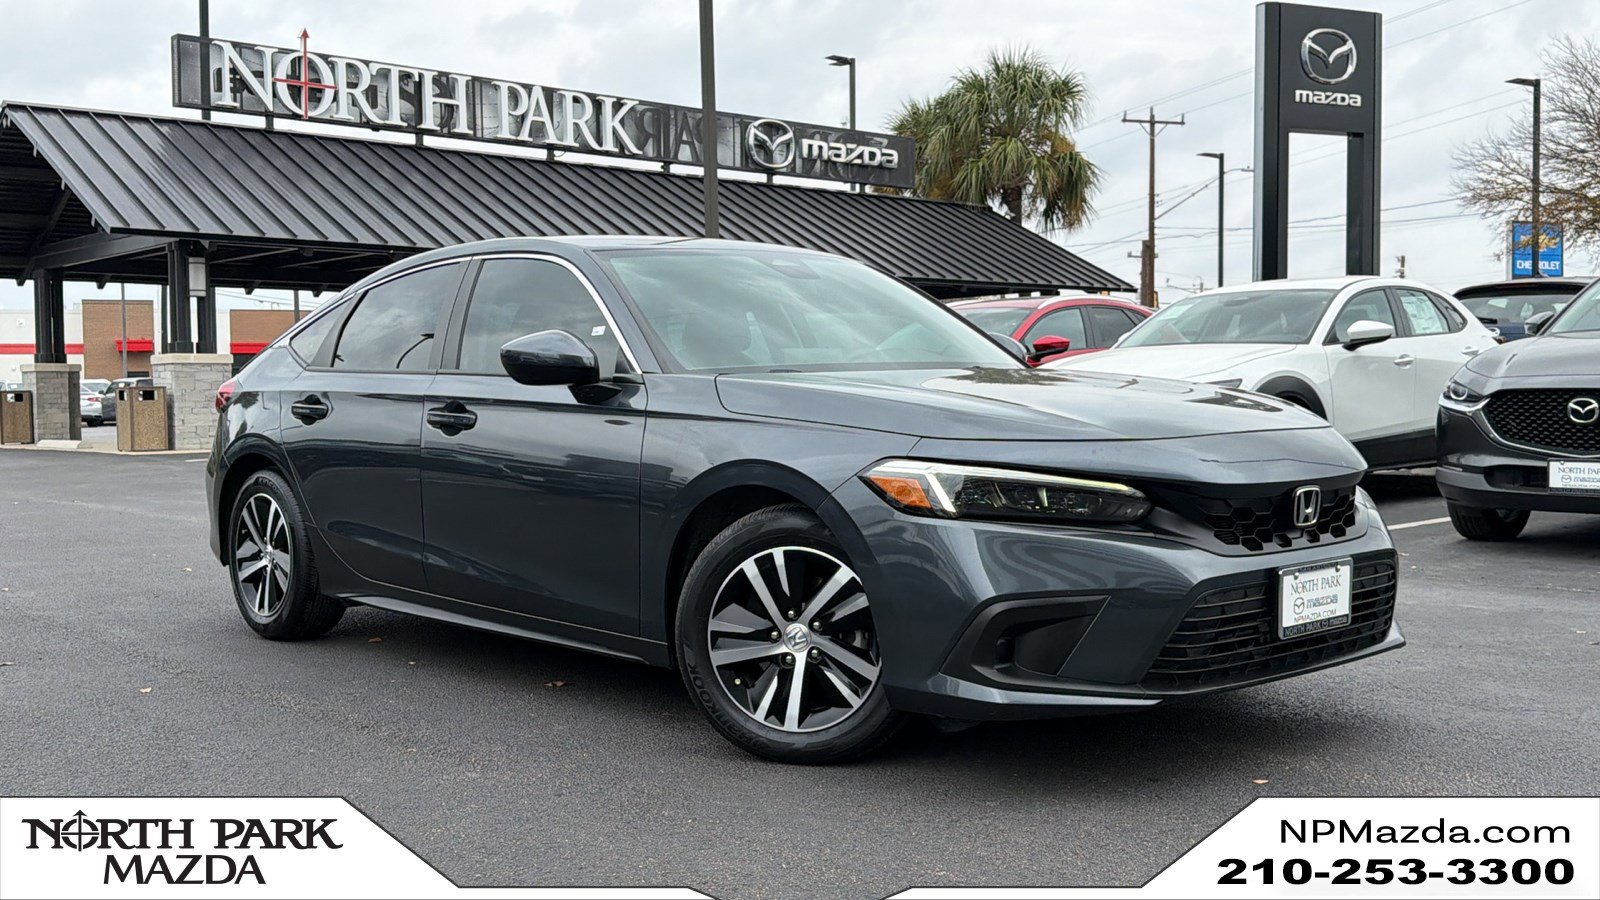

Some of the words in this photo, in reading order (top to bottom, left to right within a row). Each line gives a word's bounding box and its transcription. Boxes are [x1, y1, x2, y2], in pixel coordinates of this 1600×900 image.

[211, 39, 473, 134] NORTH
[491, 80, 643, 155] PARK
[1295, 89, 1362, 107] mazda
[801, 138, 899, 168] mazda
[1516, 260, 1560, 270] CHEROLET
[1291, 578, 1318, 595] NORTH
[1321, 575, 1342, 589] PARK
[1307, 594, 1338, 609] mazda
[1285, 626, 1305, 636] NORTH
[1306, 621, 1321, 631] PARK
